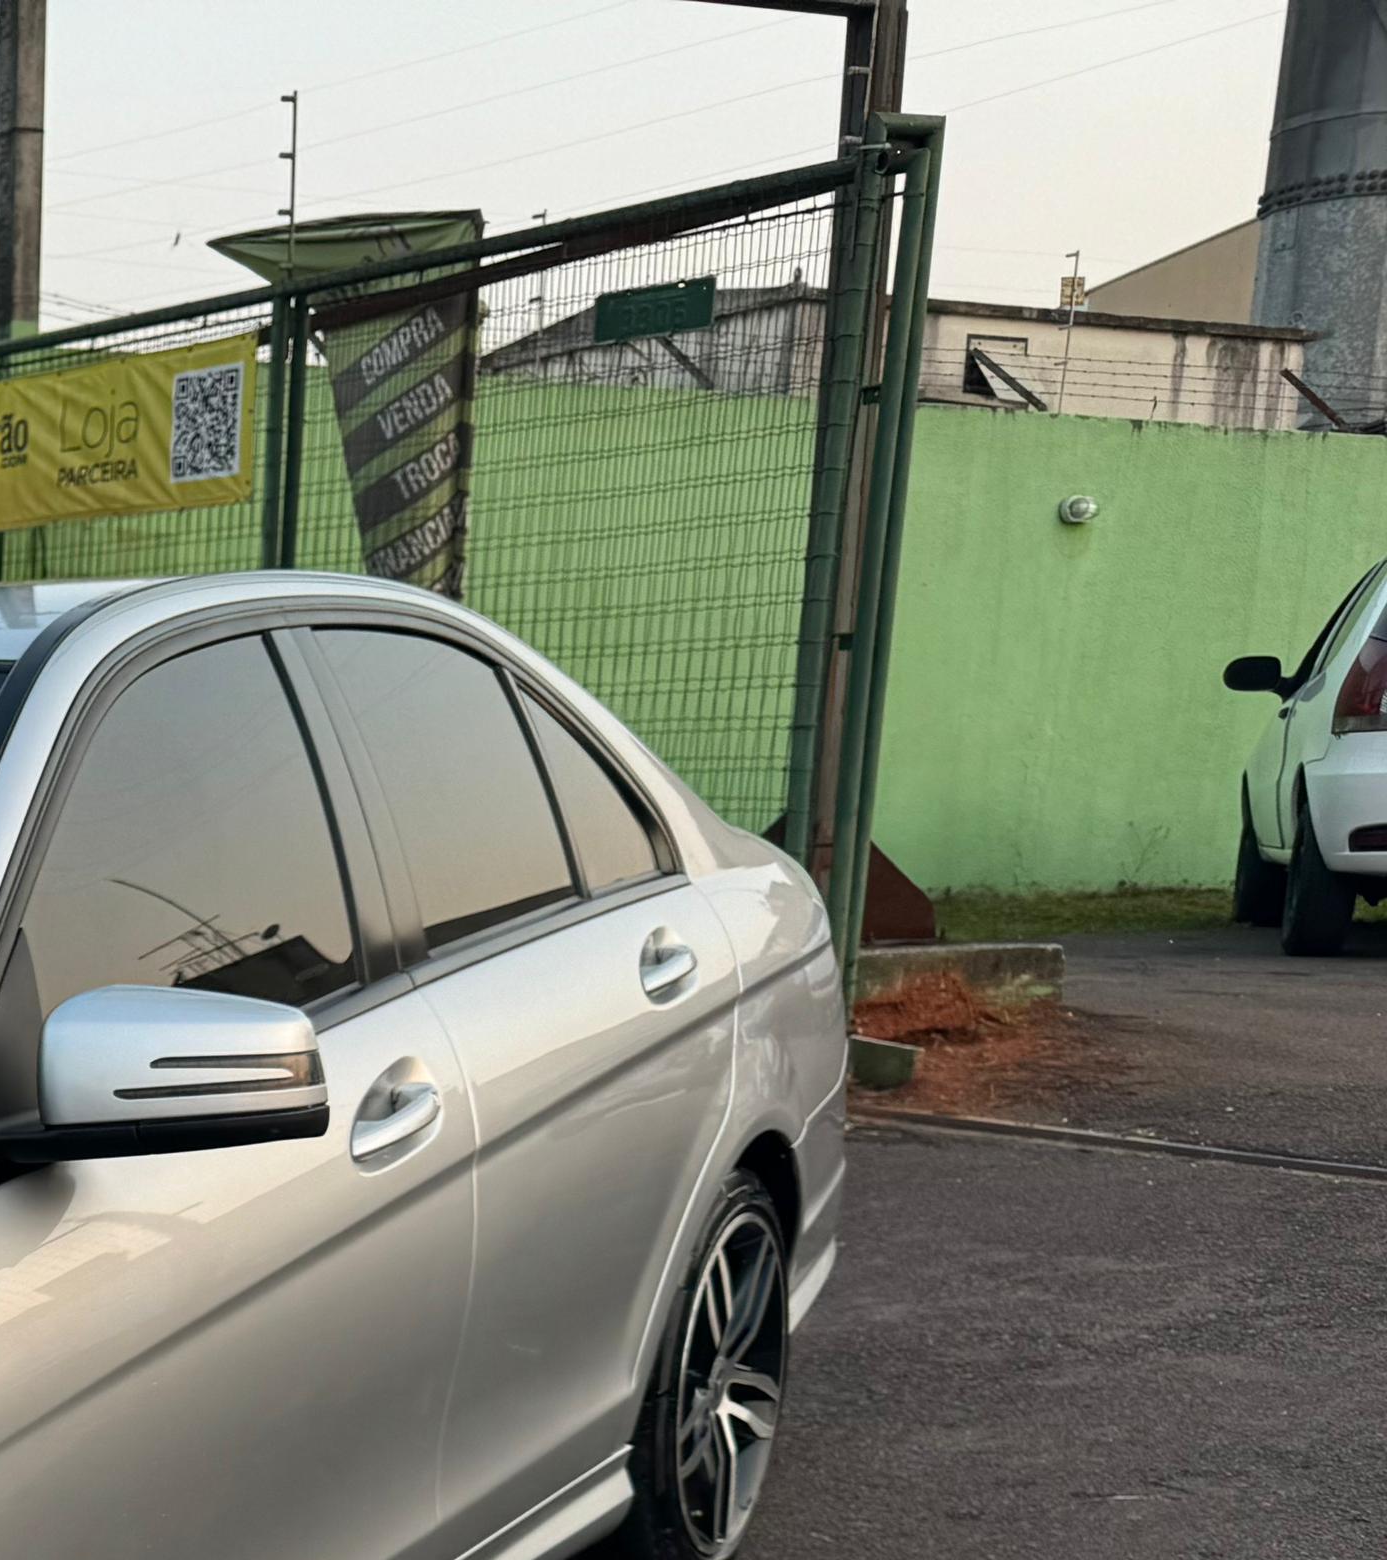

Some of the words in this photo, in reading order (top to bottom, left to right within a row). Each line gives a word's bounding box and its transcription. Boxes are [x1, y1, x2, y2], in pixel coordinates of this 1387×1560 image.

[361, 306, 444, 385] COMPRA
[59, 386, 139, 459] Loja
[378, 373, 453, 440] VENDA
[57, 458, 138, 488] PARCEIRA
[390, 432, 460, 499] TROCA
